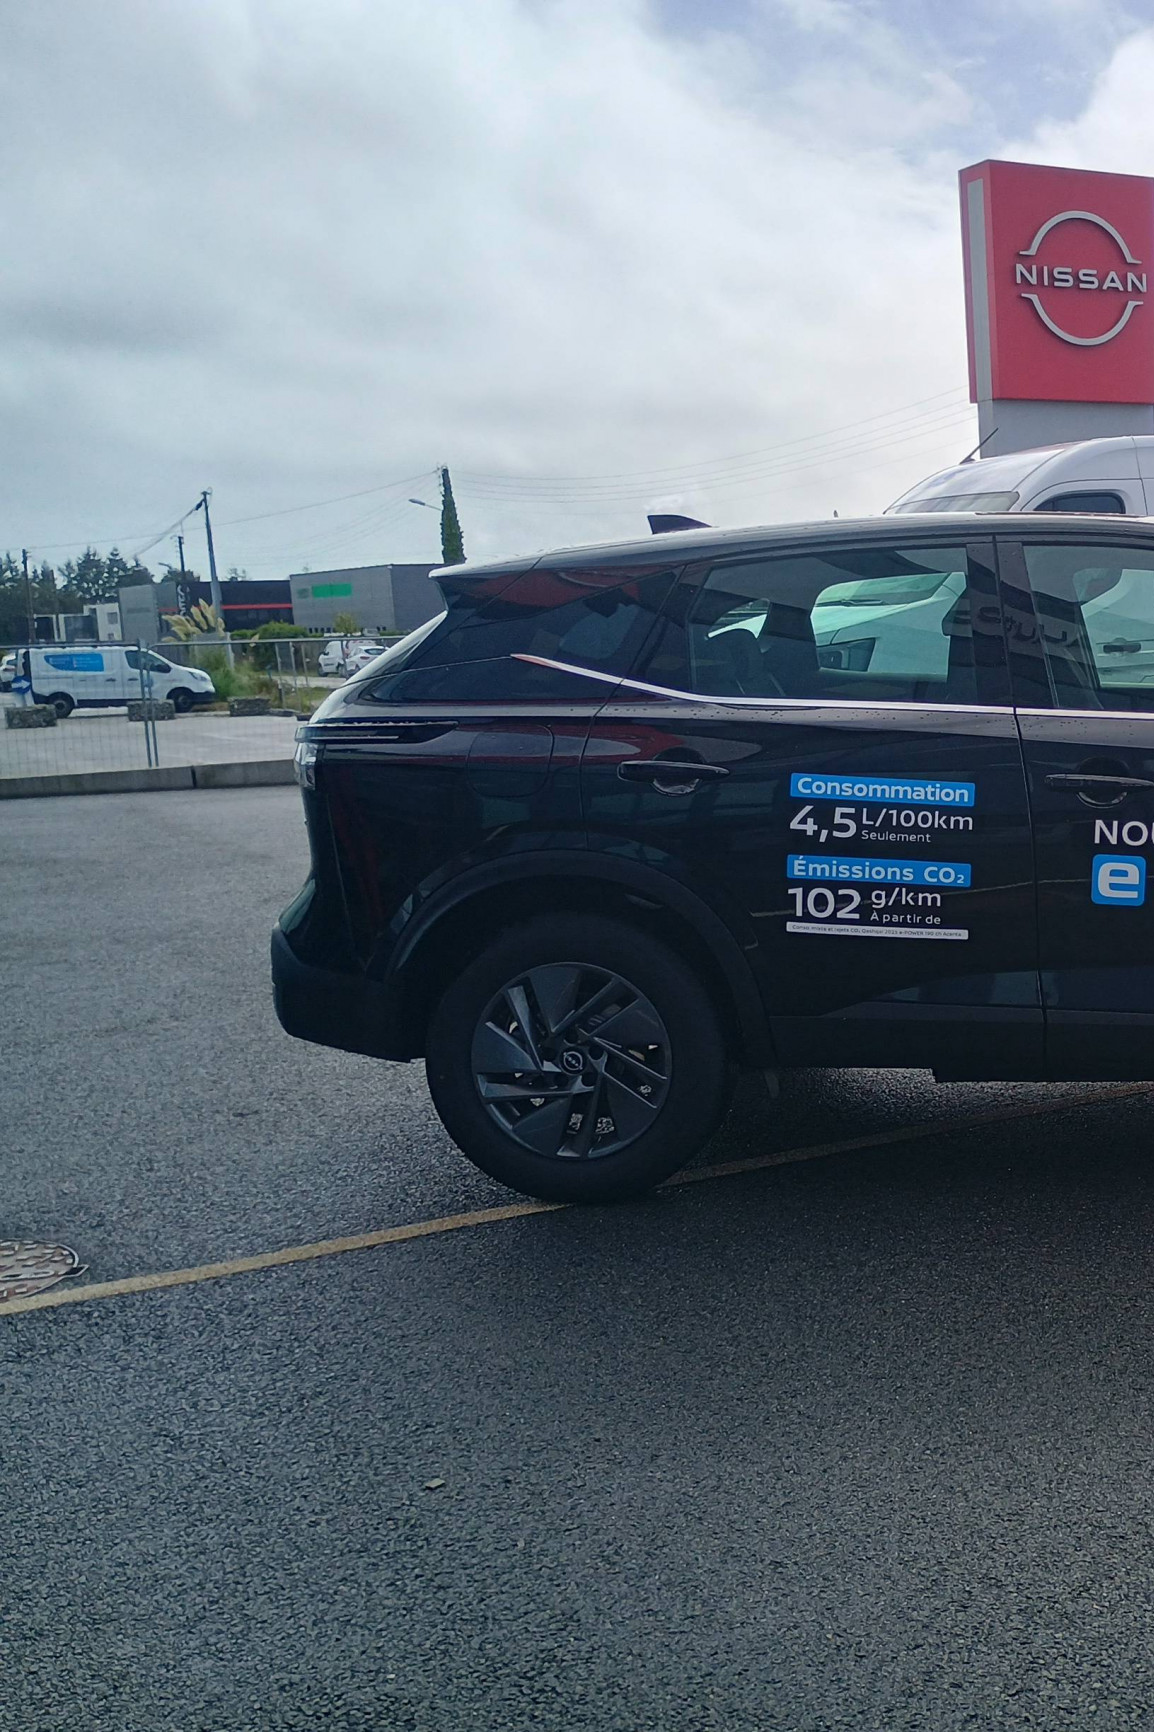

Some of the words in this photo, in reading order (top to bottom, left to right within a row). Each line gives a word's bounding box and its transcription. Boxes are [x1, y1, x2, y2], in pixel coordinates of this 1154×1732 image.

[1015, 263, 1147, 293] NISSAN
[797, 777, 969, 803] Consommation
[789, 805, 857, 843] 4,5
[862, 808, 974, 831] L/100km
[861, 830, 932, 843] Seulement
[793, 856, 914, 882] Émissions
[787, 887, 862, 919] 102
[871, 887, 942, 909] g/km
[870, 910, 880, 921] À
[882, 912, 922, 925] partir
[925, 914, 941, 925] de
